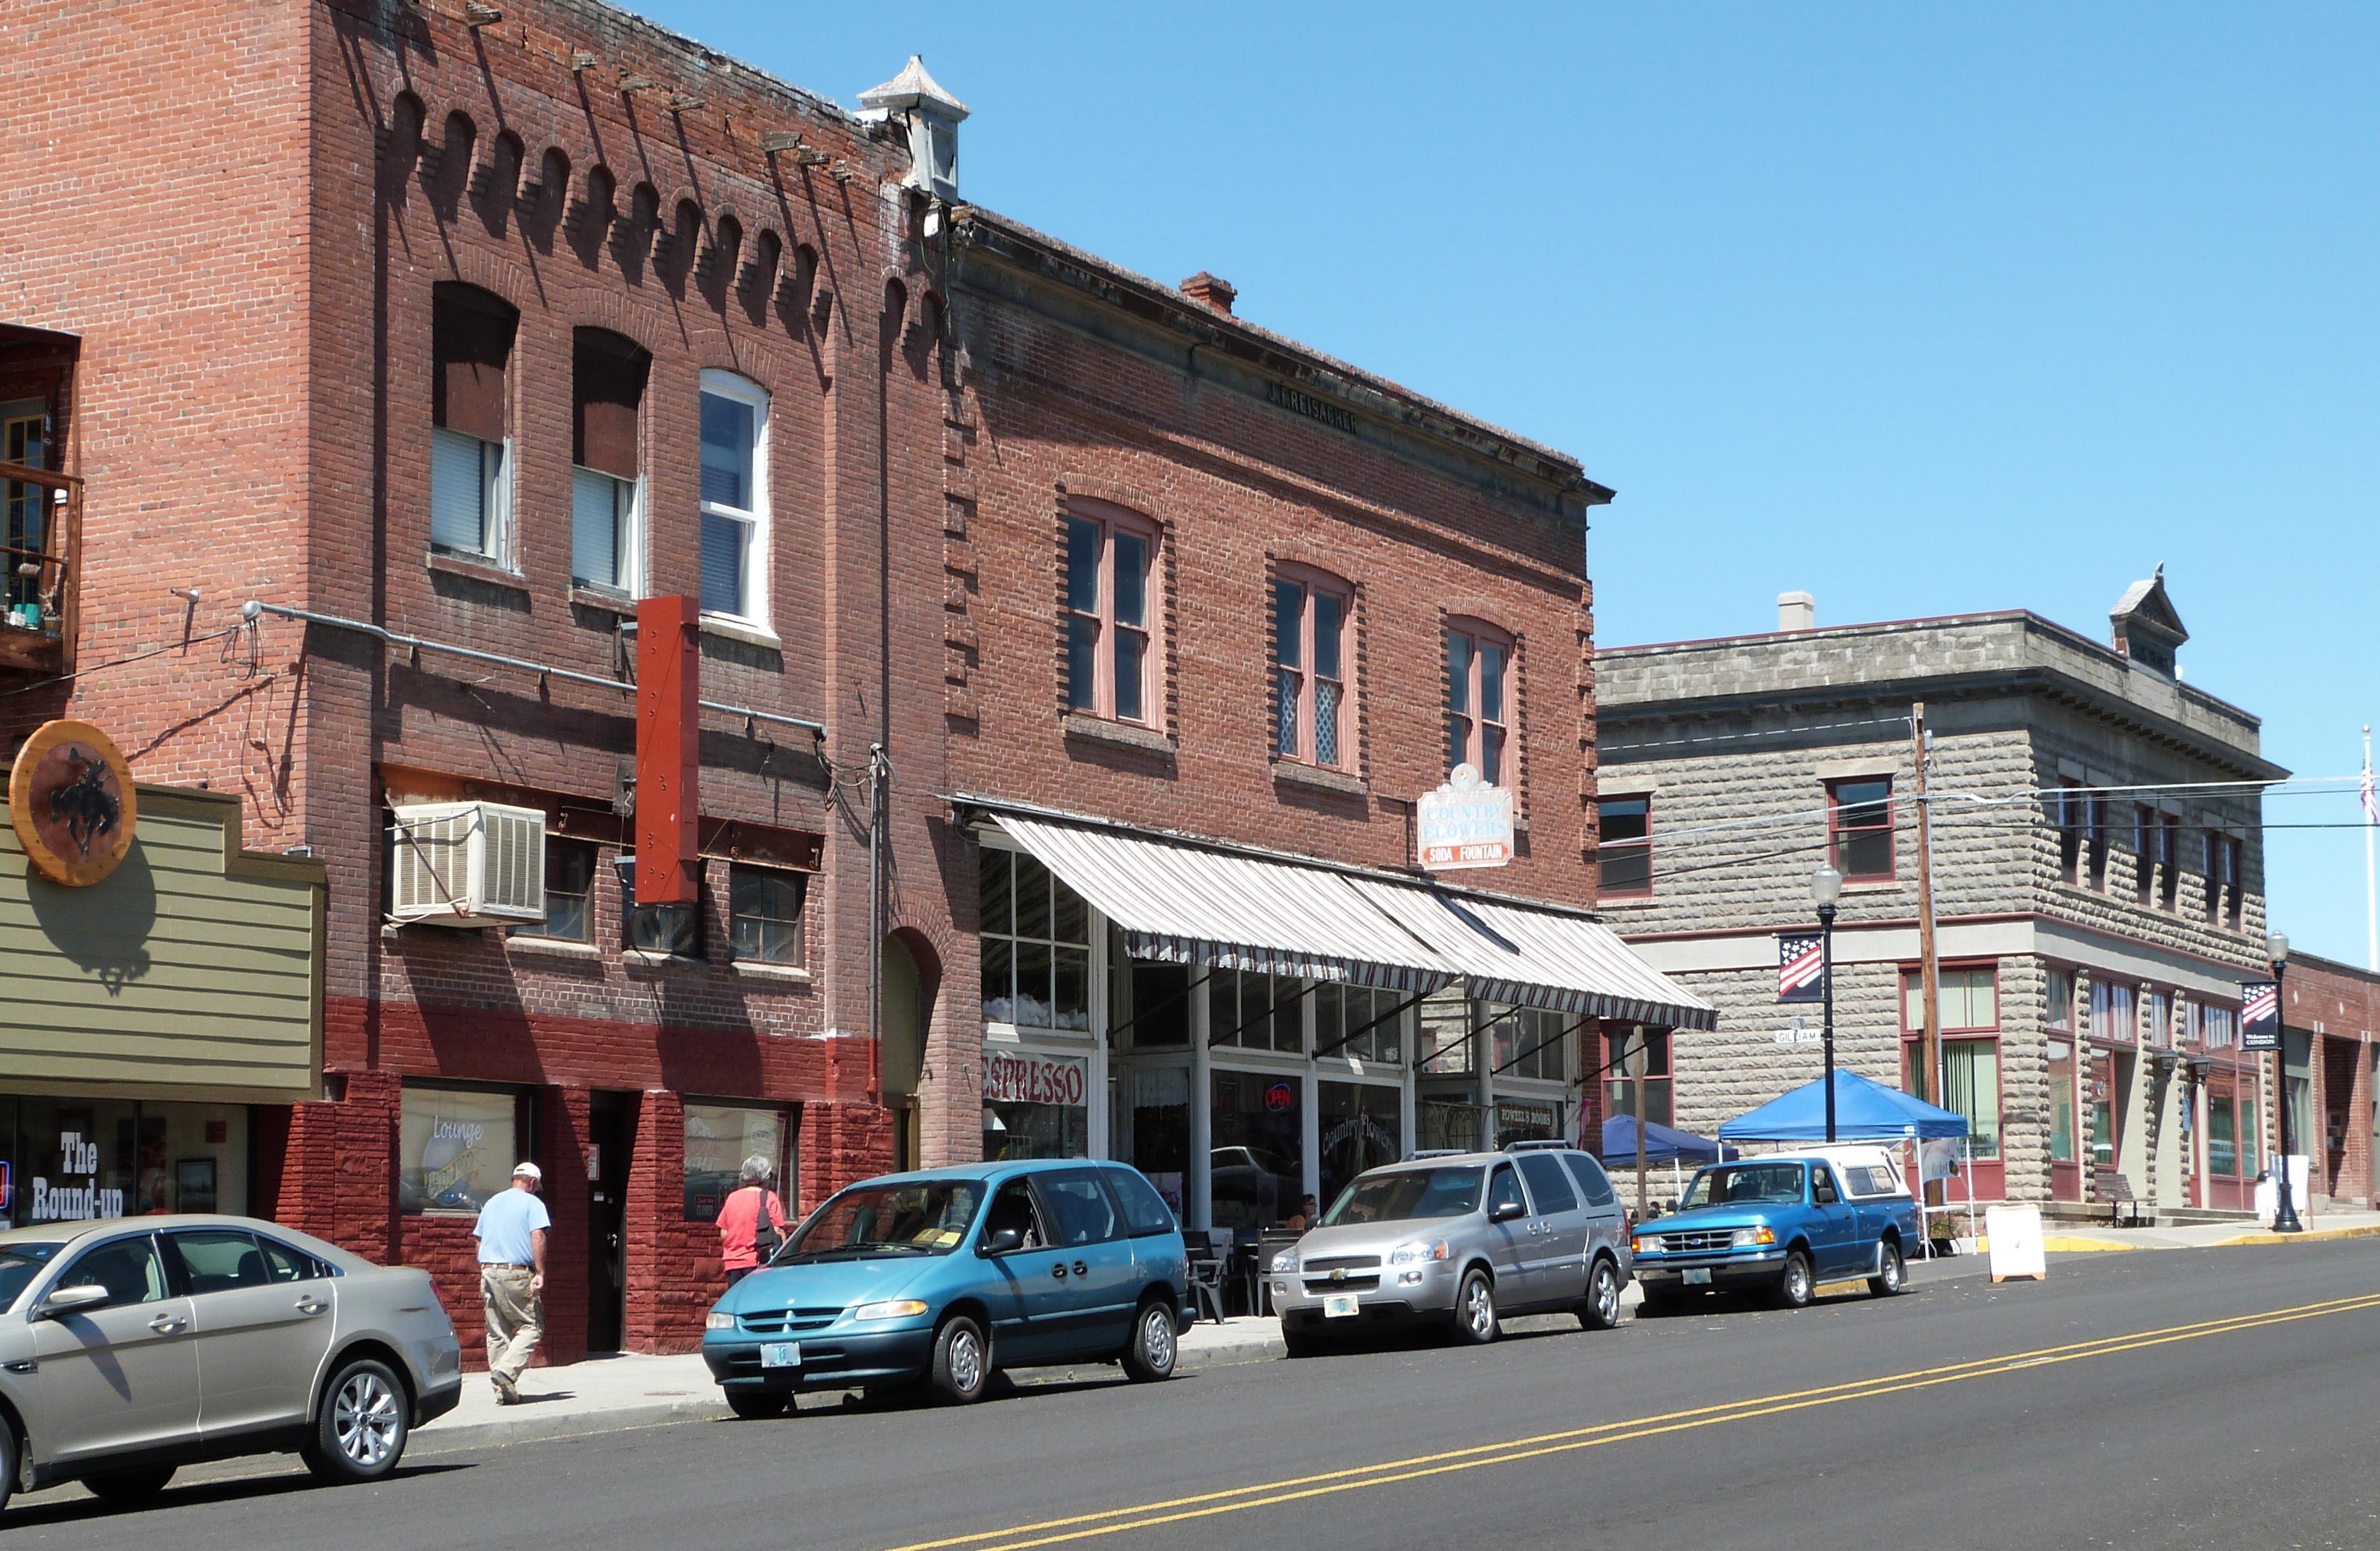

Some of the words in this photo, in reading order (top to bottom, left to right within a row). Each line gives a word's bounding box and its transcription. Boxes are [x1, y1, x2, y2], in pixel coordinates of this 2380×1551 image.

[1424, 819, 1508, 839] FLOWERS
[1426, 803, 1503, 822] COUNTRY
[1429, 847, 1453, 863] SODA
[1460, 844, 1502, 861] FOUNTAIN
[982, 1056, 1082, 1104] ESPRESSO
[1265, 1089, 1290, 1106] OPEN
[434, 1115, 484, 1148] Lounge
[1322, 1117, 1359, 1157] Country
[61, 1132, 97, 1174] The
[32, 1177, 123, 1220] Round-up
